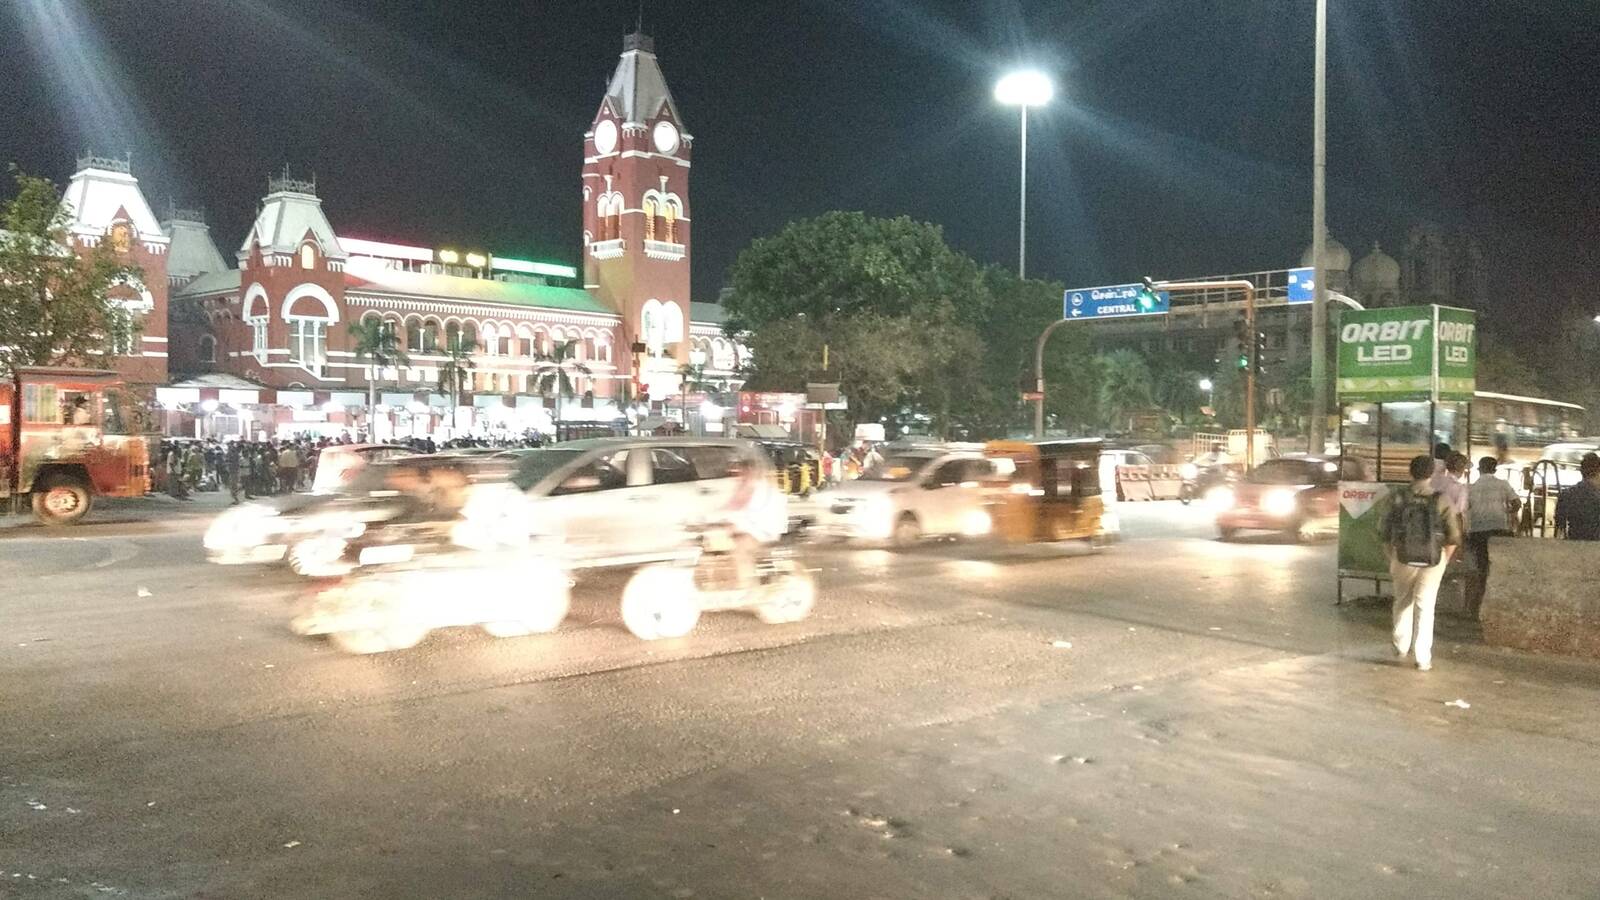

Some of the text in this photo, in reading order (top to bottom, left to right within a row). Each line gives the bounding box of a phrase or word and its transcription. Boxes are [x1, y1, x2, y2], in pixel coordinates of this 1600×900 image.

[1097, 304, 1137, 314] CENTRAL
[1341, 319, 1431, 343] ORBIT
[1439, 320, 1476, 343] ORBIT
[1357, 344, 1412, 361] LED
[1445, 345, 1468, 362] LED
[1342, 490, 1377, 500] ORBIT
